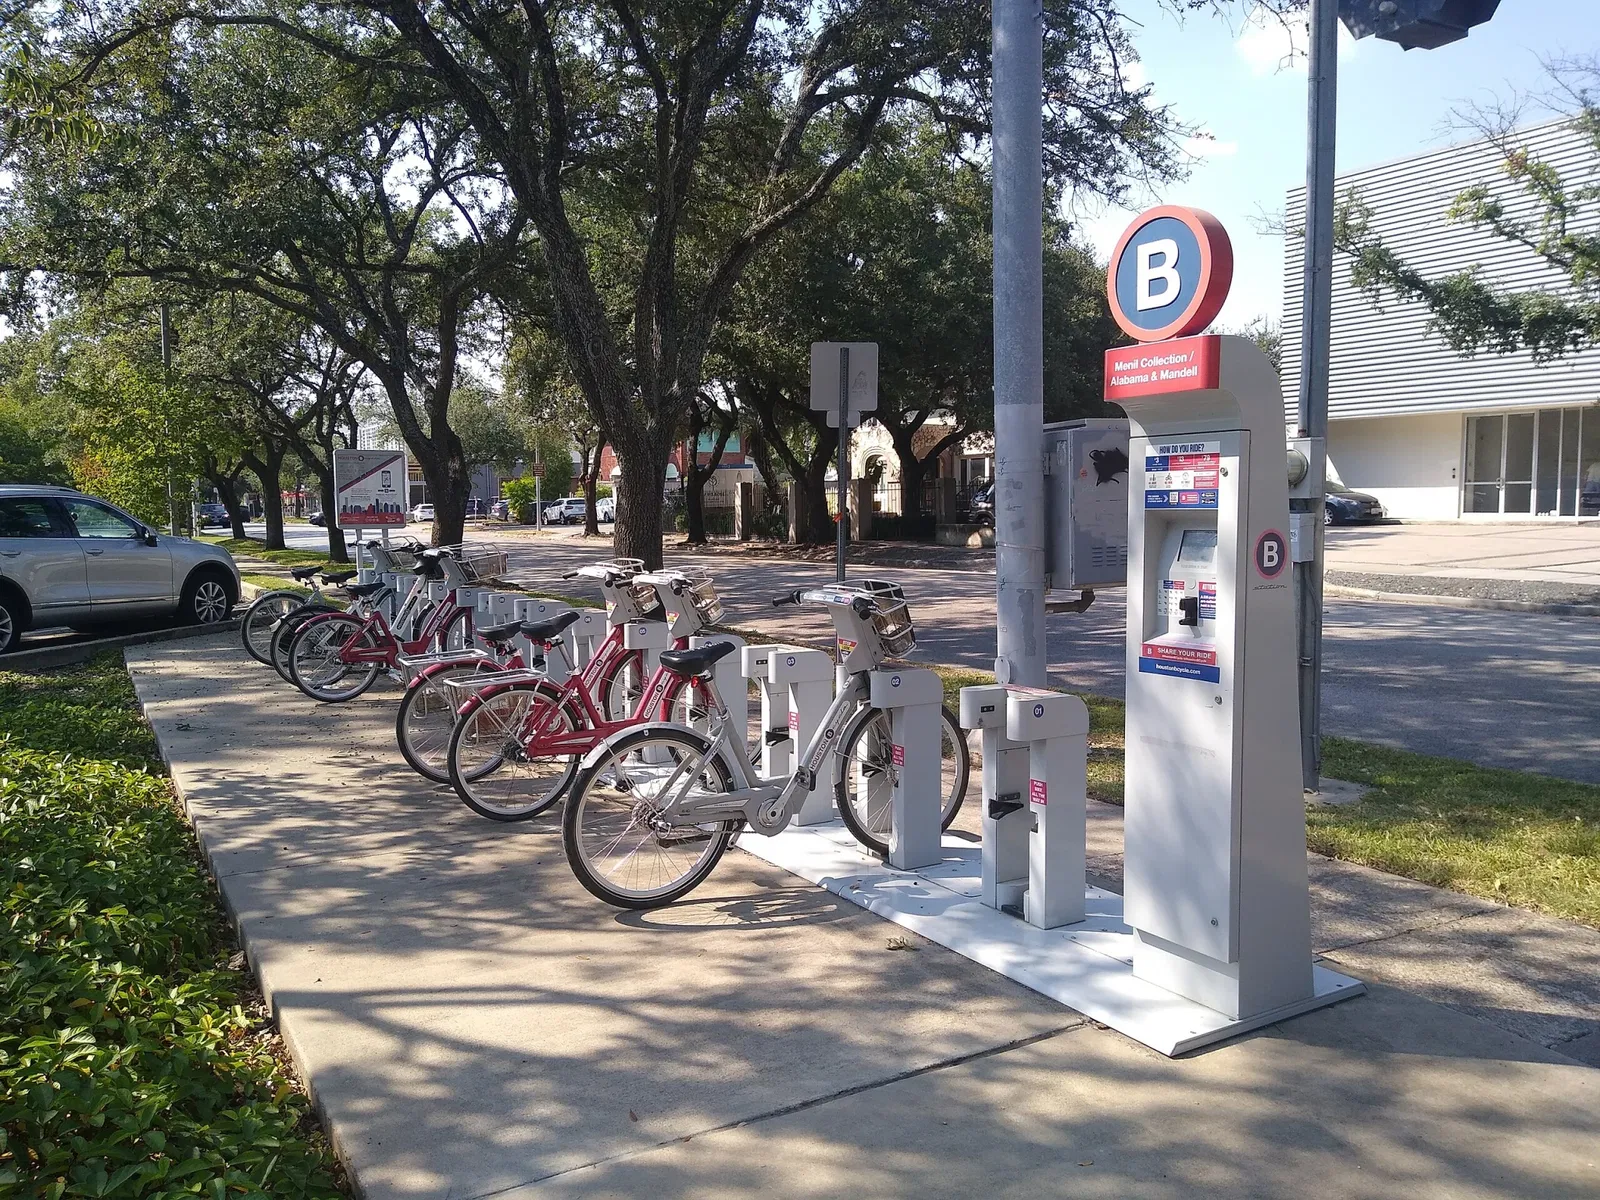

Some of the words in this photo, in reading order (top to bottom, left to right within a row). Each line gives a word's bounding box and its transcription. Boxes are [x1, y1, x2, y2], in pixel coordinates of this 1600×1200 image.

[1136, 238, 1181, 312] B
[1114, 359, 1138, 372] Menil
[1140, 354, 1187, 368] Collection
[1189, 351, 1194, 362] /
[1110, 374, 1148, 386] Alabama
[1150, 371, 1158, 381] &
[1160, 366, 1198, 380] Mandell
[1159, 445, 1170, 454] HOW
[1171, 445, 1179, 453] DO
[1179, 444, 1189, 453] YOU
[1190, 443, 1205, 453] RIDE?
[1263, 540, 1279, 567] B
[787, 657, 795, 665] 03
[891, 678, 900, 686] 02
[644, 692, 660, 718] HOUSTON
[809, 738, 829, 770] HOUSTON
